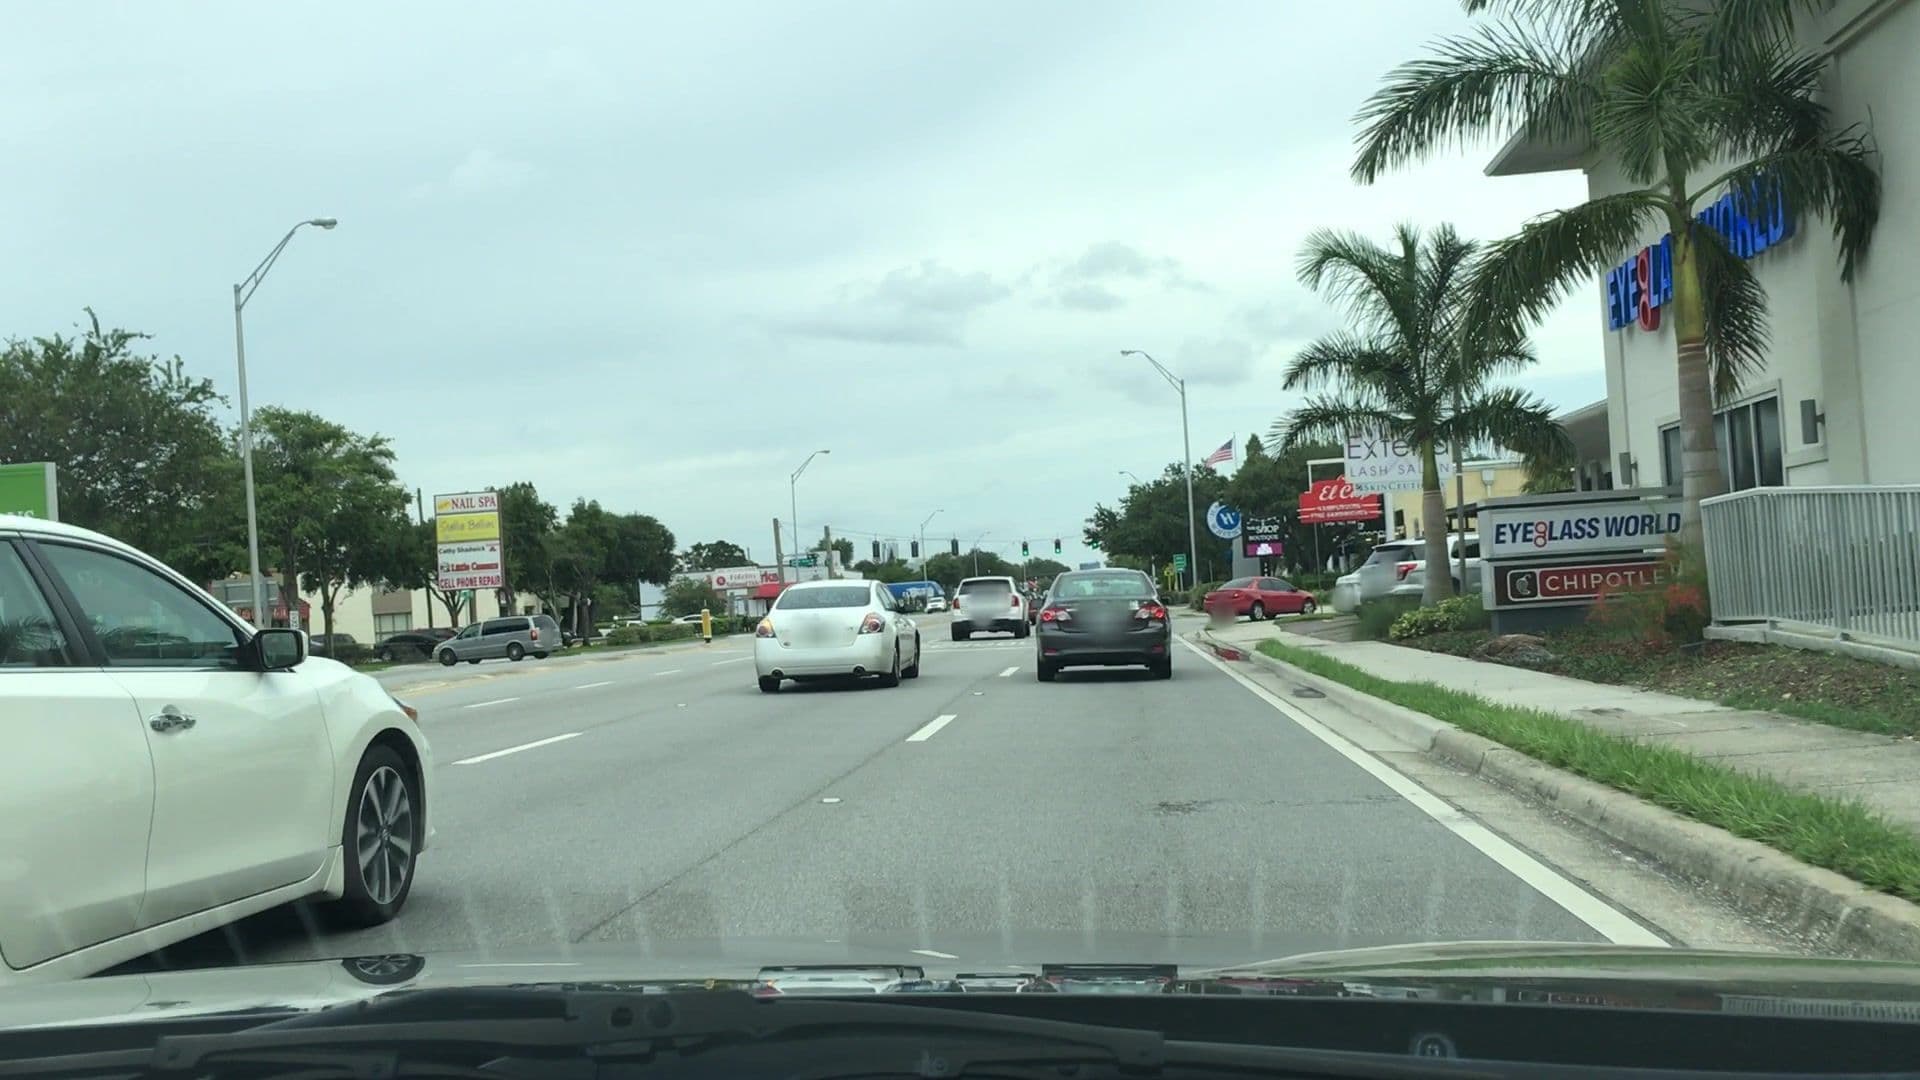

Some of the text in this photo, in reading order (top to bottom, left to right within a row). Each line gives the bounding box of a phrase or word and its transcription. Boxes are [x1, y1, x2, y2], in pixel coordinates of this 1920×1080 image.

[1608, 233, 1674, 331] EYEGLA
[1350, 462, 1450, 478] LASH SALN
[451, 498, 476, 509] NAIL
[479, 496, 497, 508] SPA
[1605, 512, 1681, 538] WORLD
[440, 576, 501, 588] CELL PHONE REPAIR
[1545, 569, 1666, 591] CHIPOTLE
